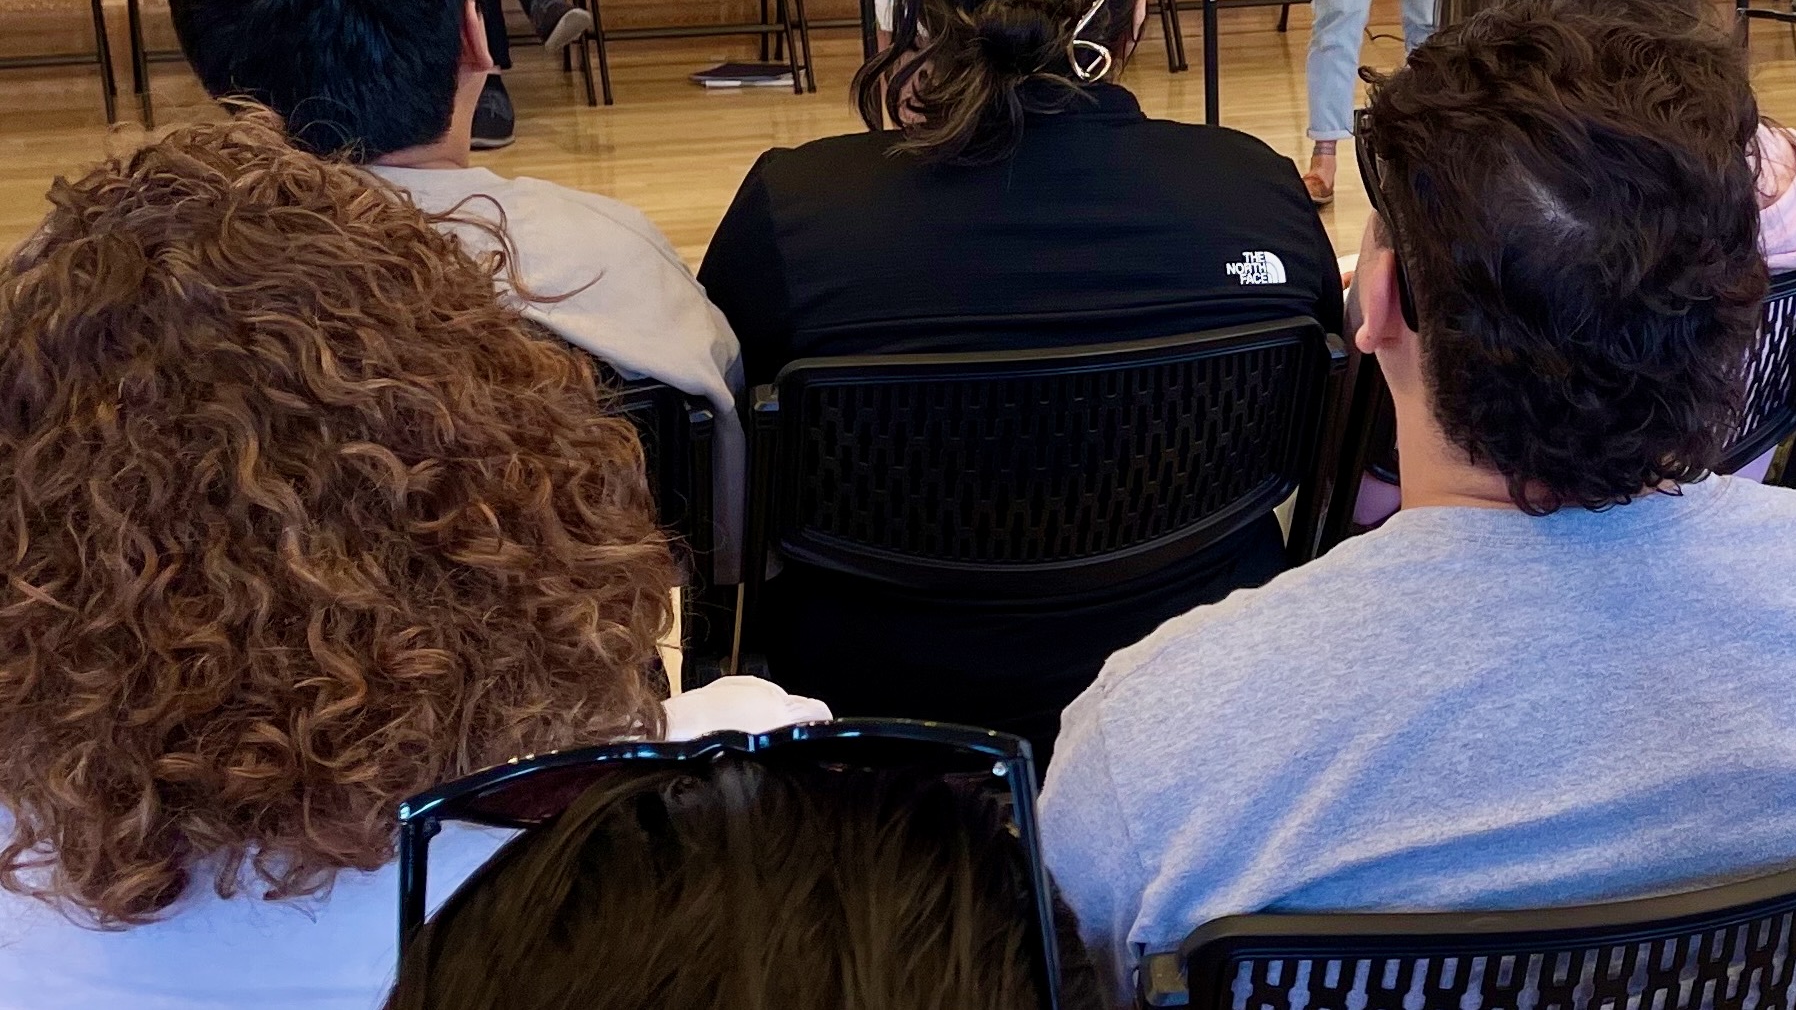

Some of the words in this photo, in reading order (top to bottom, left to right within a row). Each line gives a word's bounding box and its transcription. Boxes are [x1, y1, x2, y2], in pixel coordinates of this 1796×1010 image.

[1242, 251, 1265, 263] THE
[1226, 262, 1267, 275] NORTH
[1240, 273, 1268, 285] FACE
